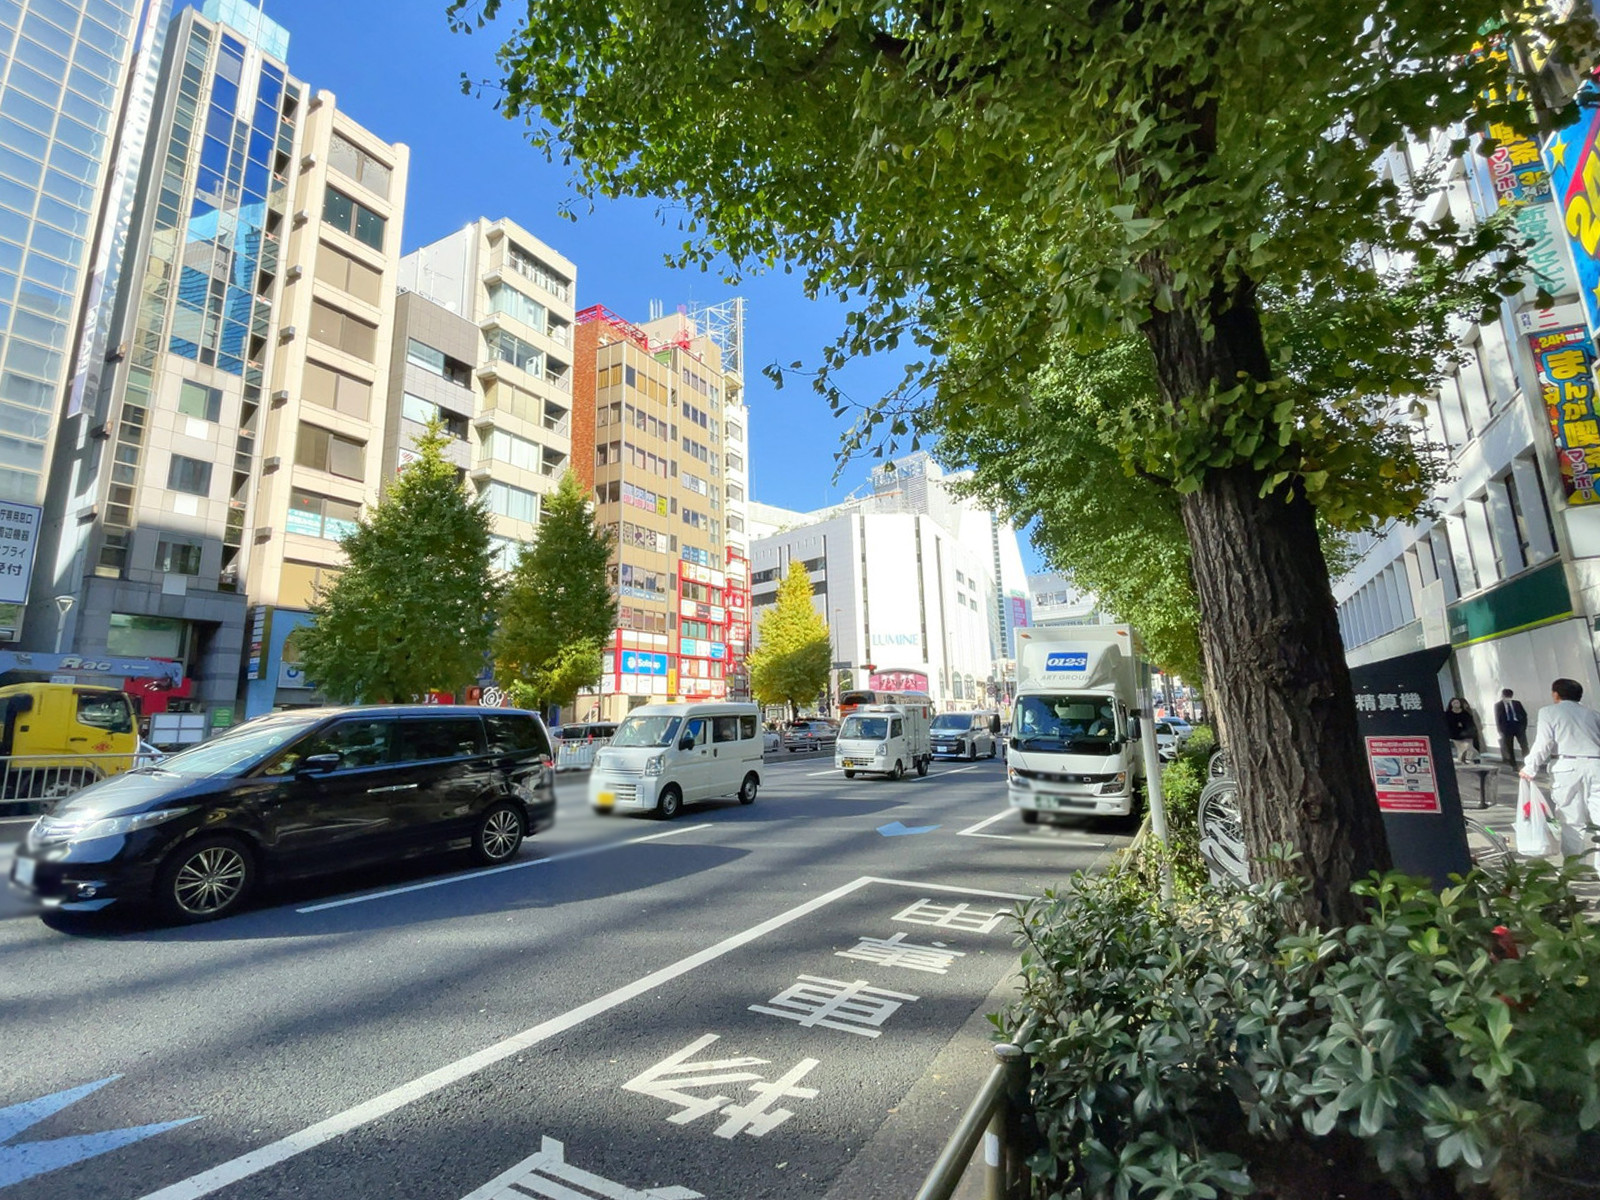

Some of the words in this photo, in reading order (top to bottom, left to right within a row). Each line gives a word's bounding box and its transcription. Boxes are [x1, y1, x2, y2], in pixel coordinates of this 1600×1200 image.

[872, 633, 919, 646] LUMINE
[1047, 656, 1087, 666] 0123
[1355, 692, 1423, 711] 精算機
